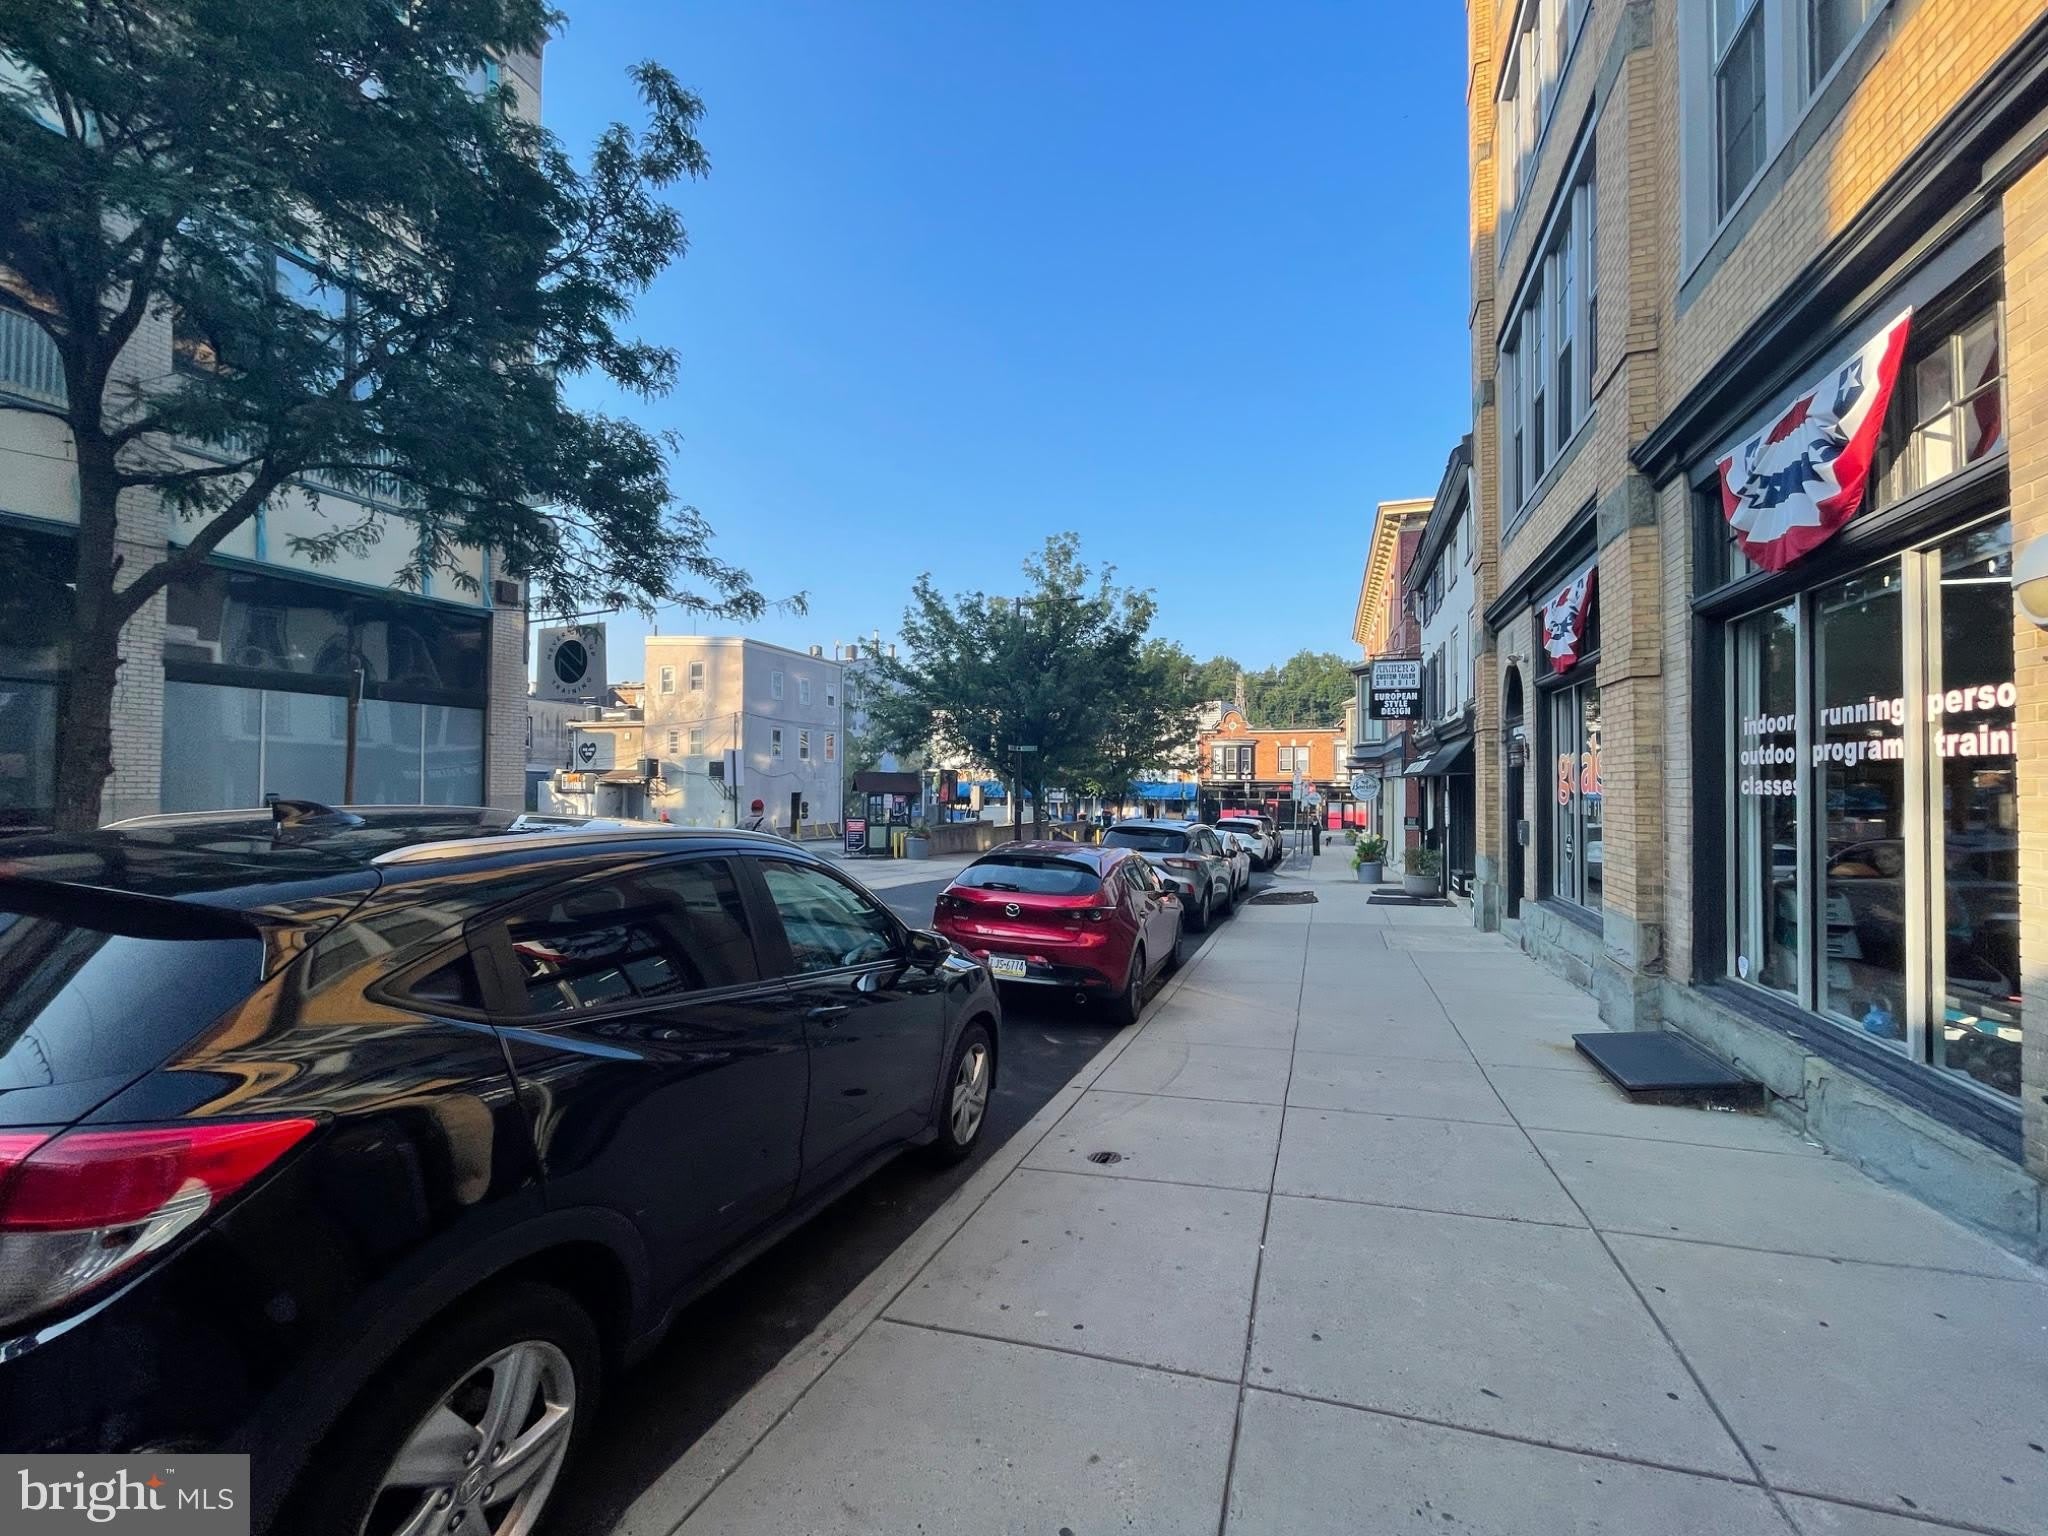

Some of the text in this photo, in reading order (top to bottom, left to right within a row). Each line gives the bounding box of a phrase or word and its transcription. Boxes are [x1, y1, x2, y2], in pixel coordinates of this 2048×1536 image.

[1374, 692, 1418, 701] EUROPEAN
[1384, 700, 1409, 708] STYLE
[1928, 682, 2016, 721] perso
[1380, 707, 1411, 716] DESIGN
[1820, 696, 1904, 727] running
